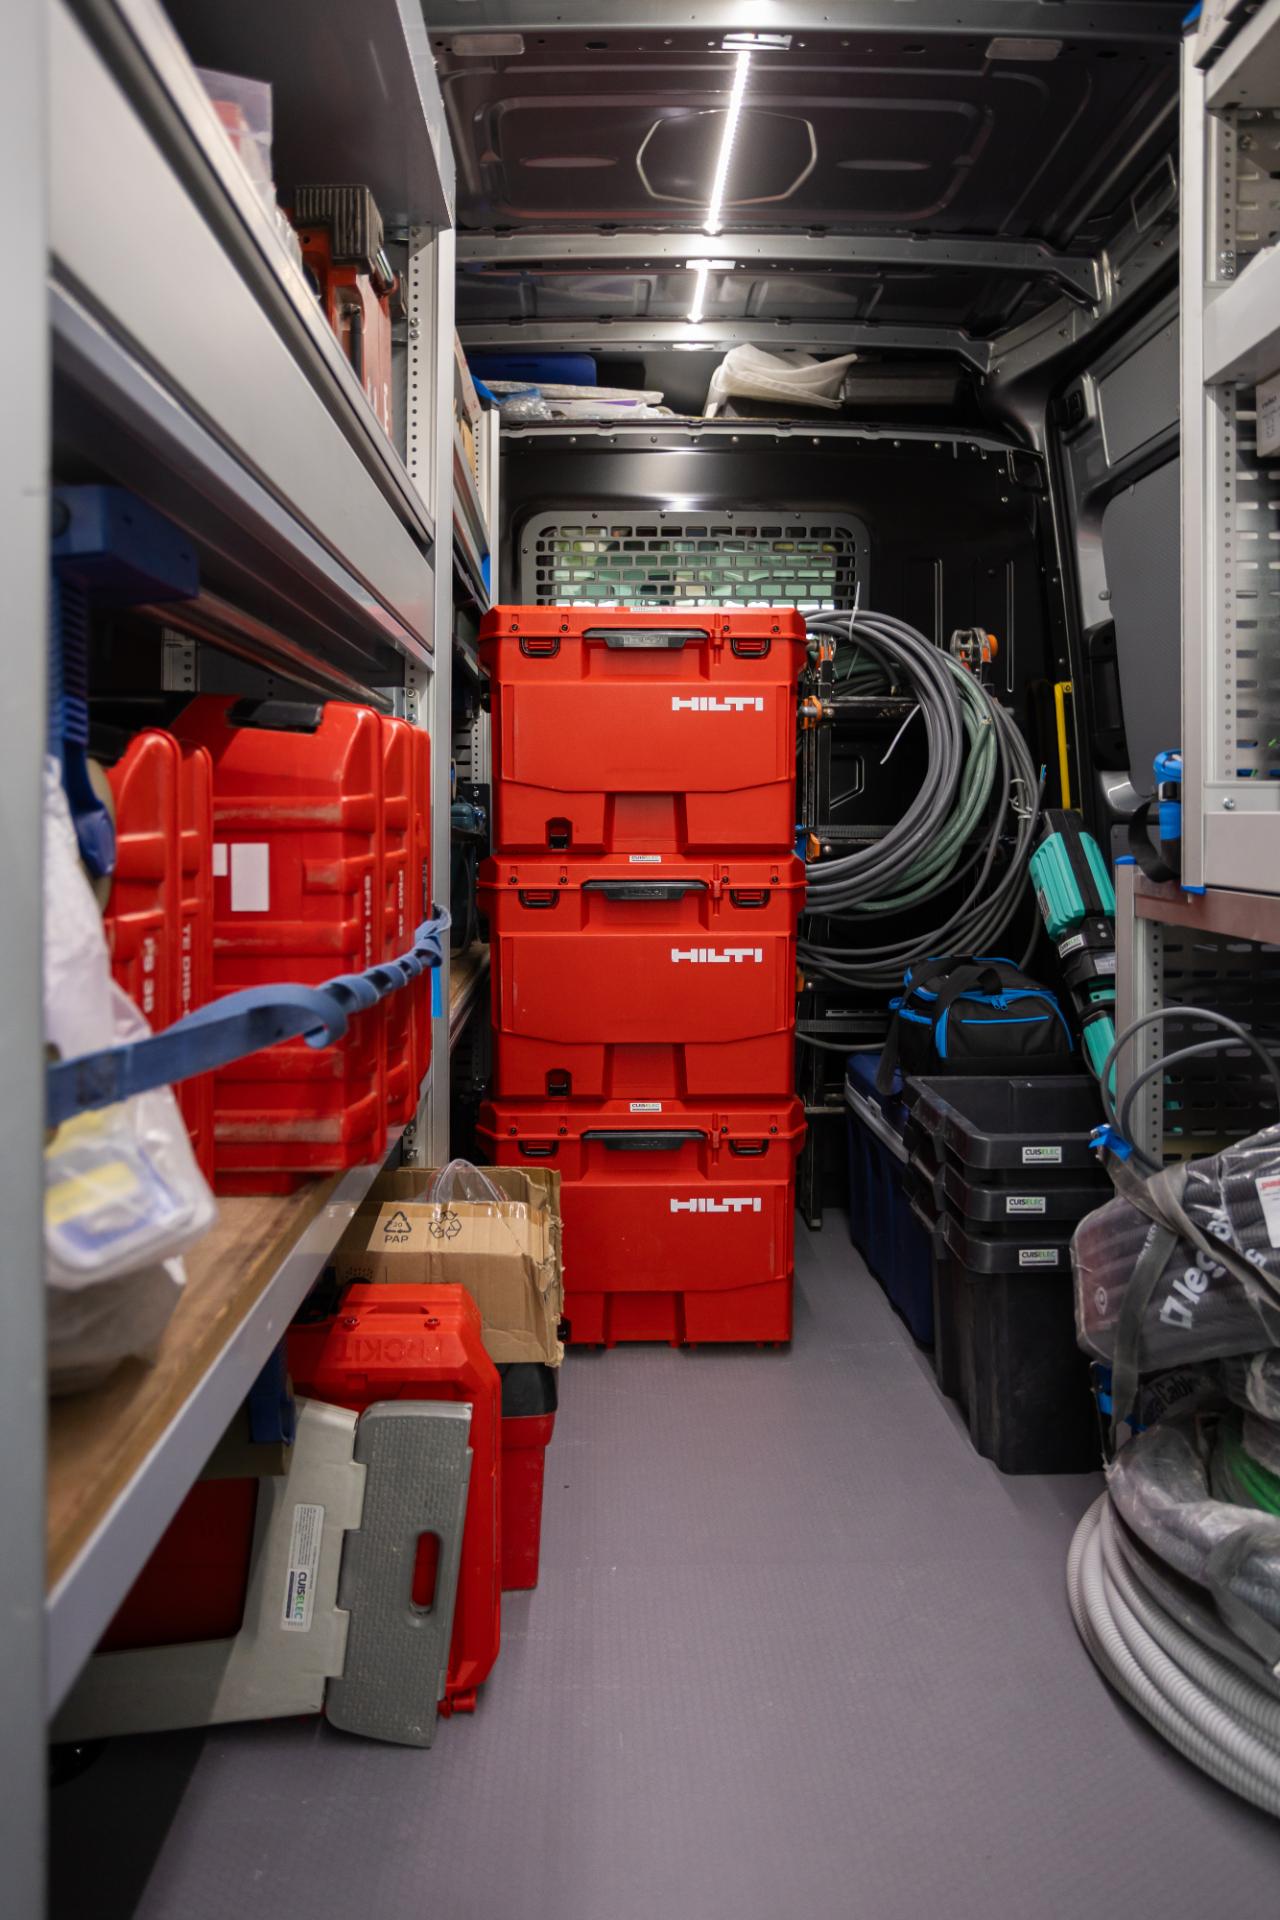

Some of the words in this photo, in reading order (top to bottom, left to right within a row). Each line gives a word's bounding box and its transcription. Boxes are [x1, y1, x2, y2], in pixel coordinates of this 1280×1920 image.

[671, 696, 764, 711] HILTI
[671, 948, 763, 963] HILTI
[1025, 1148, 1059, 1156] CUISELEC
[670, 1198, 762, 1212] HILTI
[1009, 1198, 1043, 1206] CUISELEC
[384, 1234, 409, 1244] PAP
[1021, 1251, 1056, 1259] CUISELEC
[294, 1572, 307, 1619] CUISELEC
